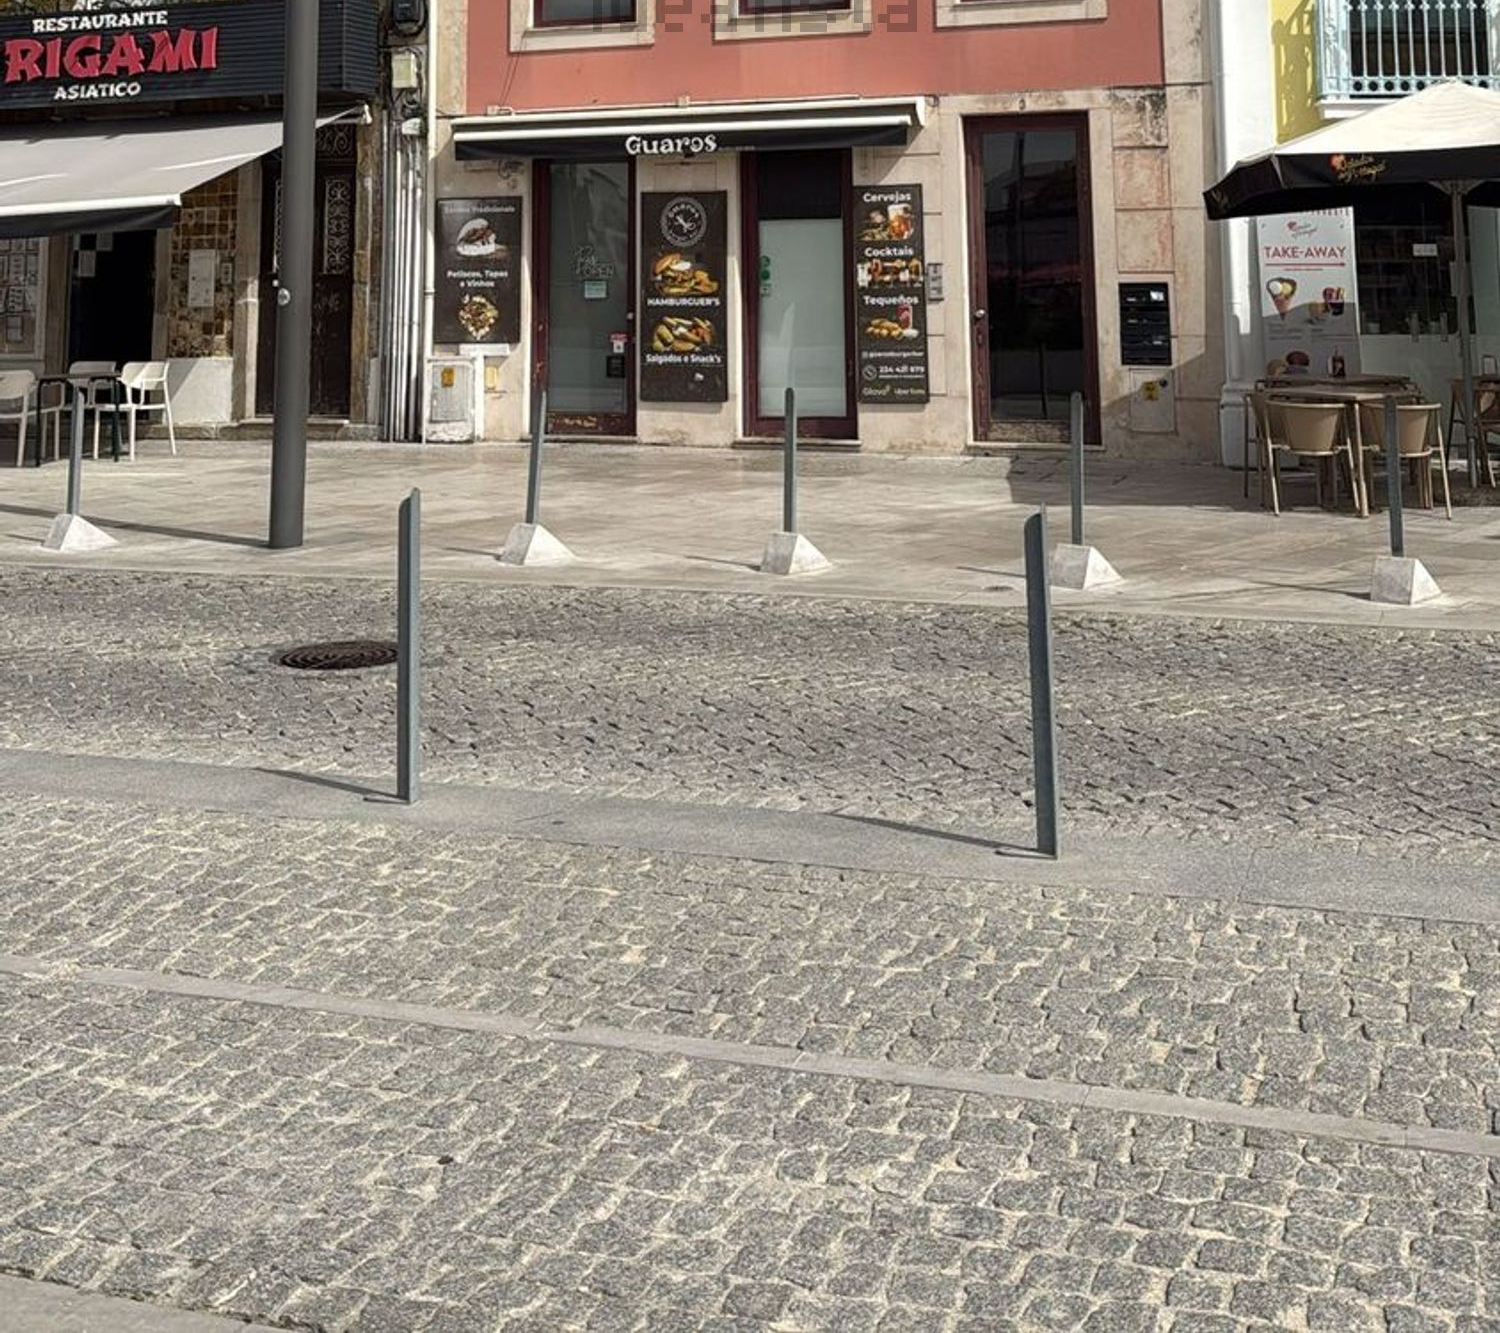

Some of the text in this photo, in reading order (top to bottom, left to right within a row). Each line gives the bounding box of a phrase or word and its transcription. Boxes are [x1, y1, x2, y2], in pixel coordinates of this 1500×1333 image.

[32, 11, 169, 34] RESTAURANTE
[4, 26, 219, 84] RIGAMI
[54, 81, 142, 101] ASIATICO
[625, 133, 718, 155] Guaros
[863, 191, 912, 203] Cervejas
[864, 245, 914, 257] Cocktais
[1263, 246, 1347, 259] TAKE-AWAY
[863, 293, 919, 306] Tequeños
